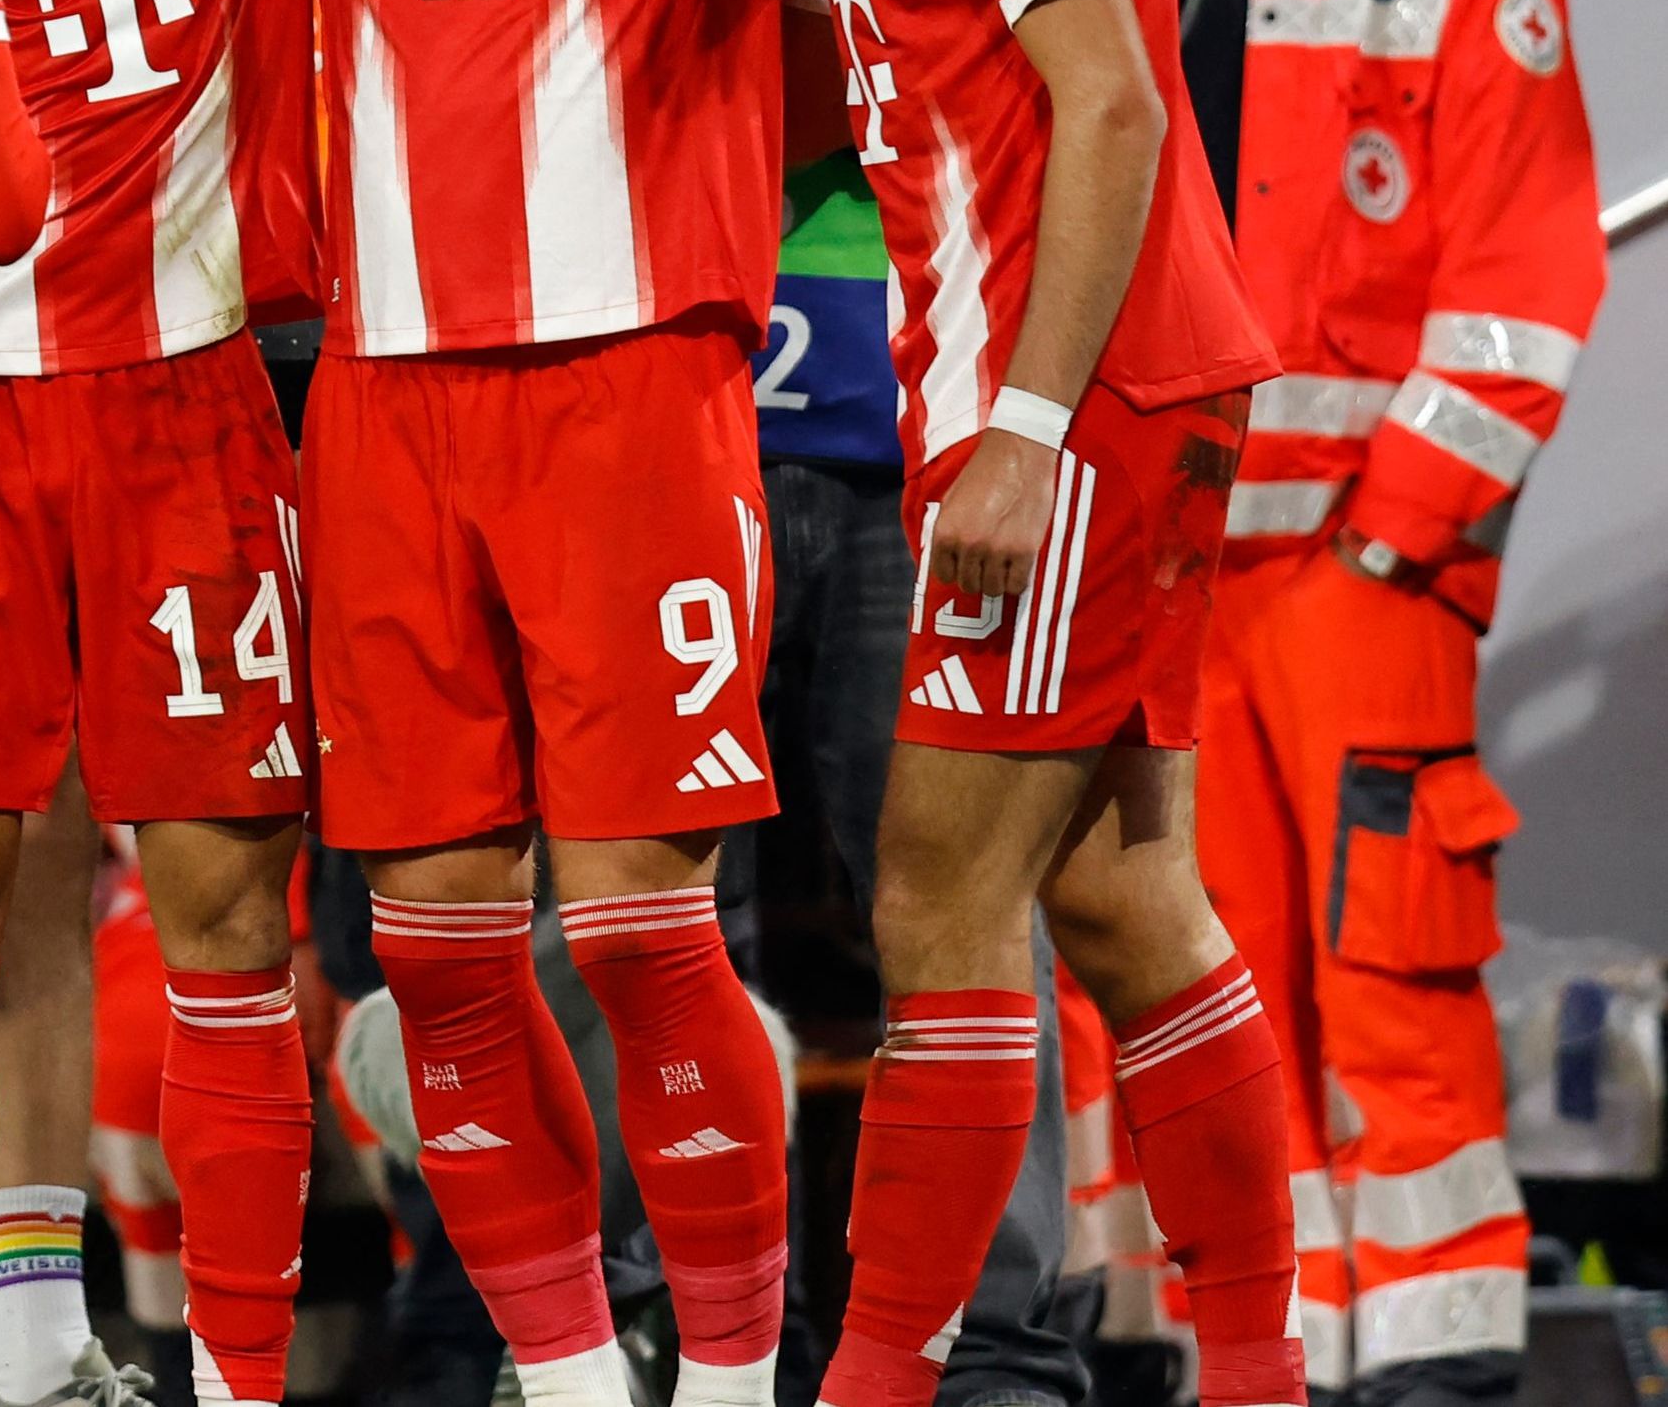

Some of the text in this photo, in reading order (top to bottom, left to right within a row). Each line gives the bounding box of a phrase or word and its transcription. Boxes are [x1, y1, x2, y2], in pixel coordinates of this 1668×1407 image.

[148, 572, 294, 719] 14
[658, 576, 739, 718] 9
[659, 1060, 698, 1077] MIA
[27, 1257, 50, 1270] IS
